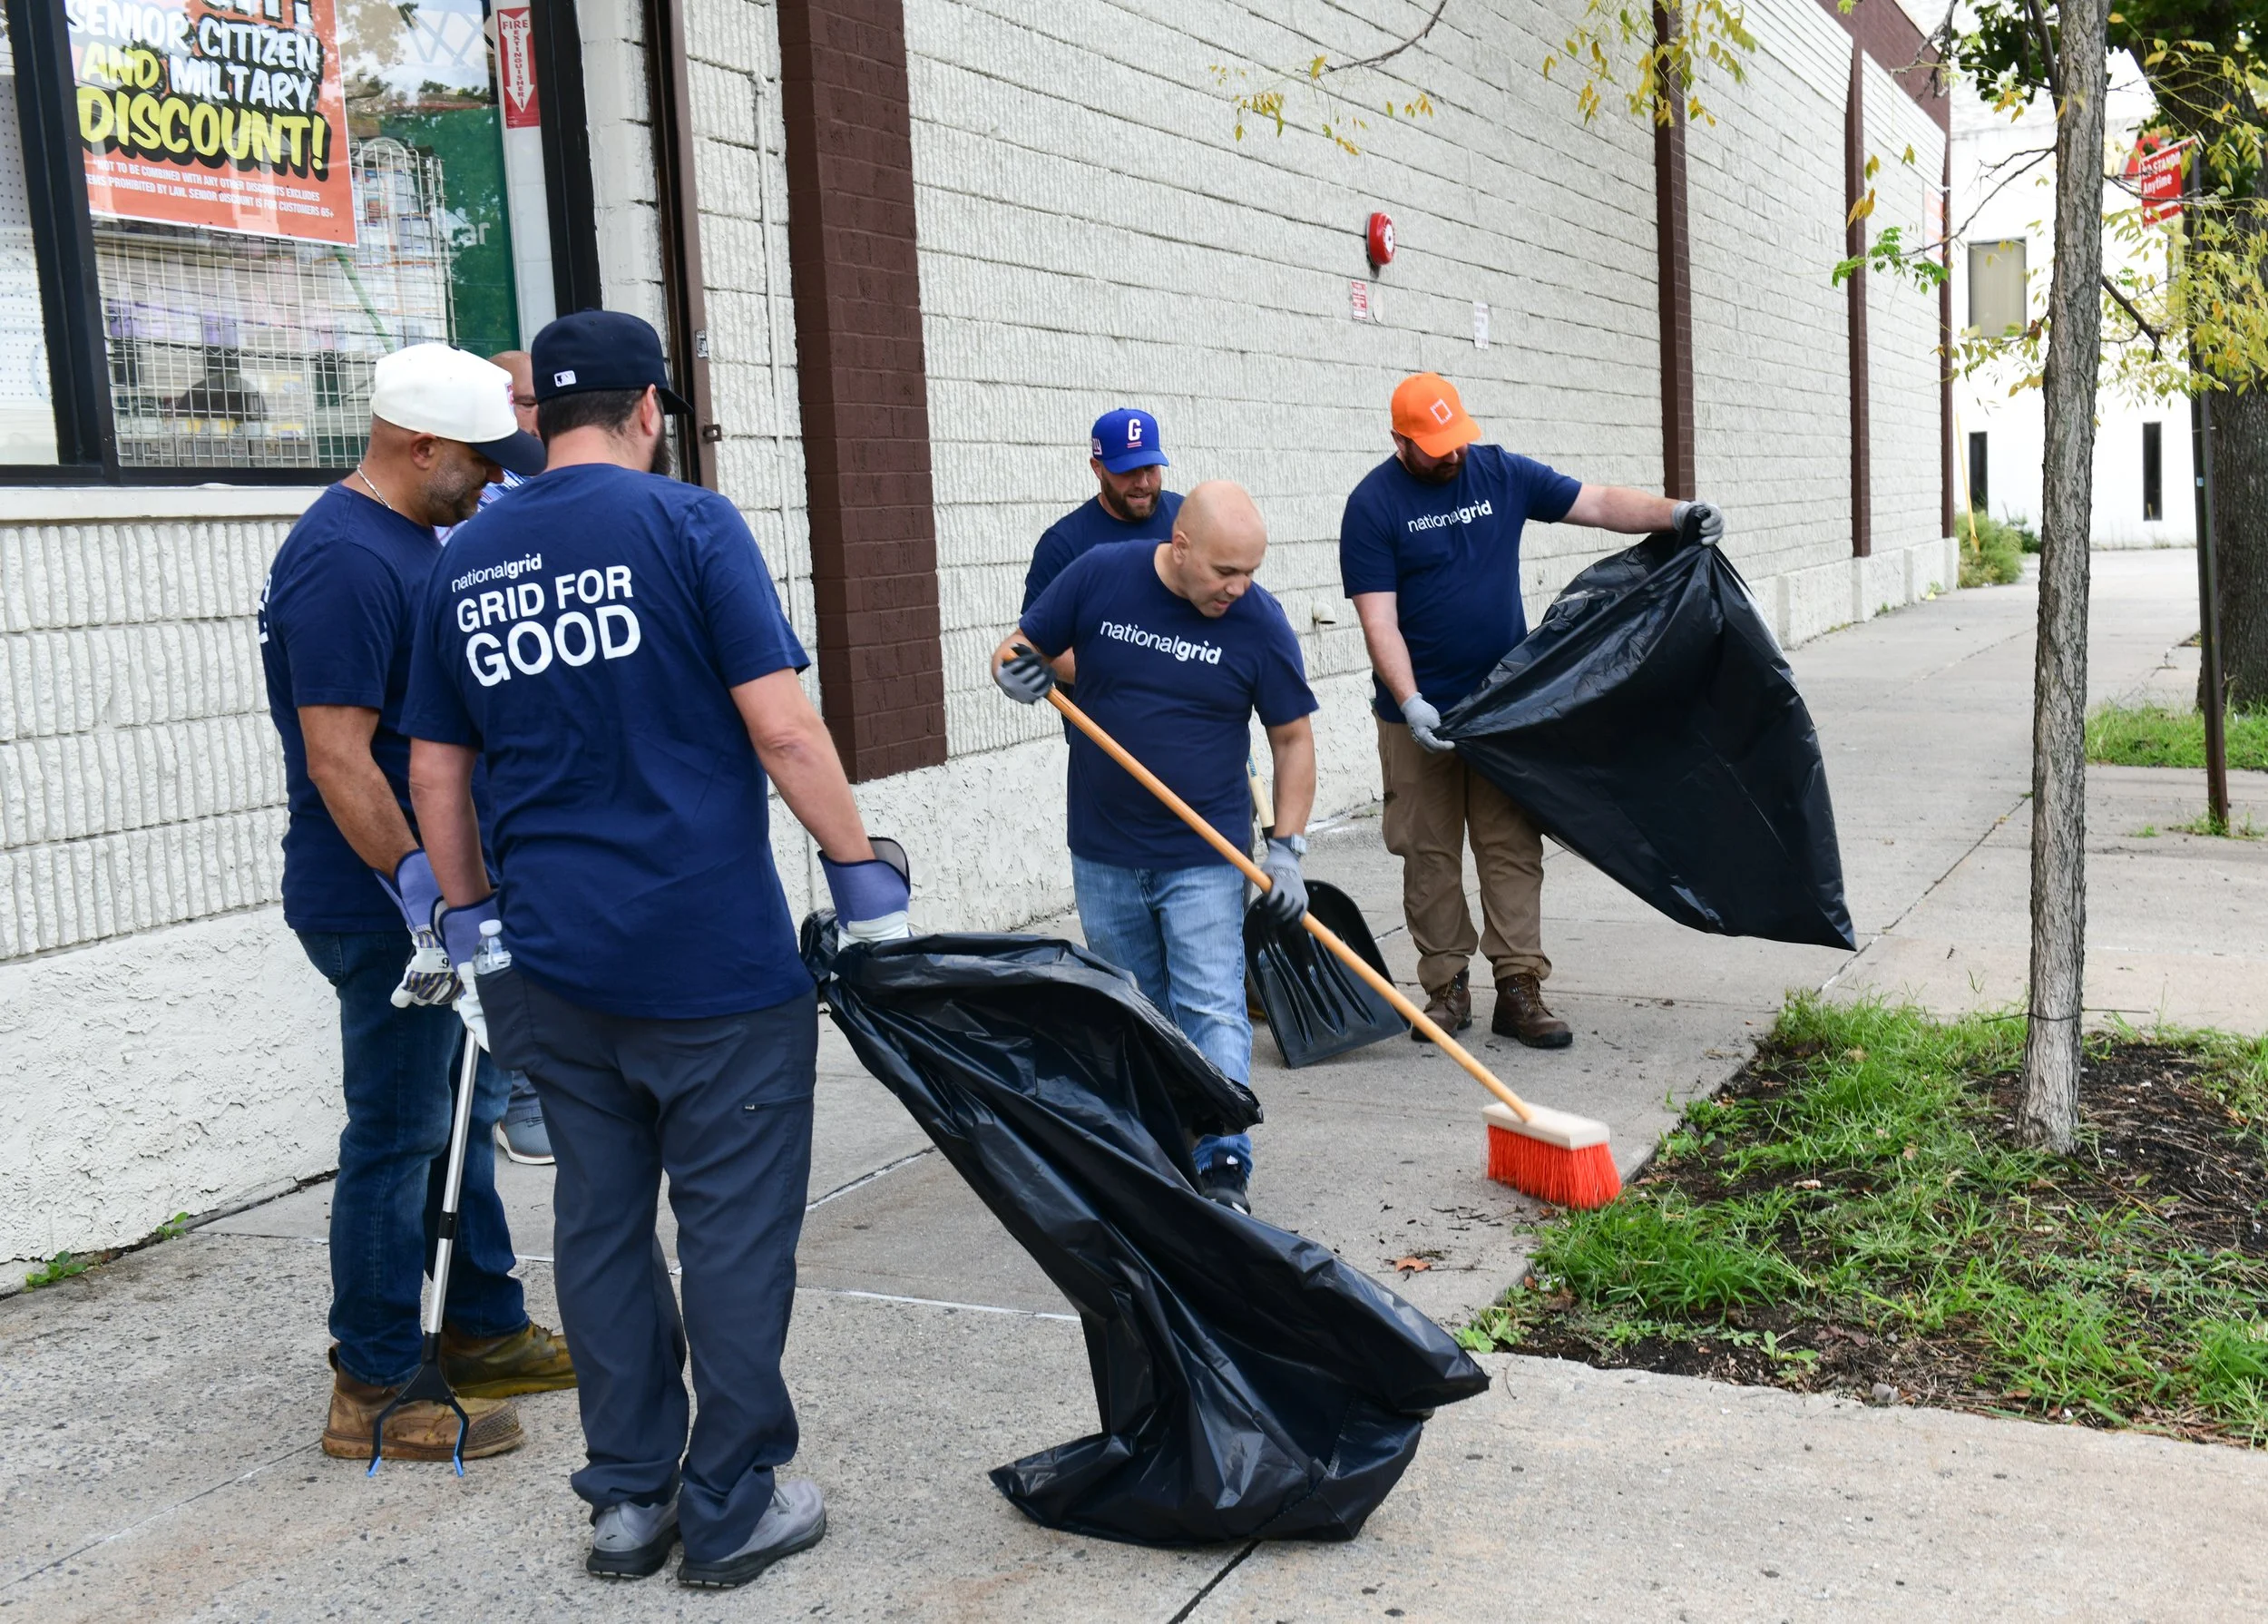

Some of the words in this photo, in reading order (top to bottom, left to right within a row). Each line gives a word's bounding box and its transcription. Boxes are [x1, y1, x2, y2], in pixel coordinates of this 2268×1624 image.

[67, 0, 191, 52] SENIOR
[198, 16, 318, 74] CITIZEN
[503, 19, 529, 30] FIRE
[82, 41, 160, 90] AND
[170, 54, 313, 113] MILTARY
[513, 30, 525, 98] EXTINGUISHER
[76, 86, 325, 170] DISCOUNT!
[108, 176, 156, 193] PROHIBITED
[156, 183, 168, 195] BY
[188, 188, 218, 201] SENIOR
[218, 191, 254, 207] DISCOUNT
[262, 199, 278, 210] FOR
[278, 201, 320, 217] CUSTOMERS
[115, 161, 128, 173] TO
[128, 164, 142, 175] BE
[141, 167, 181, 181] COMBINED
[181, 171, 202, 185] WITH
[202, 175, 219, 187] ANY
[220, 178, 245, 191] OTHER
[245, 181, 286, 197] DISCOUNTS
[285, 187, 320, 201] EXCLUDES
[2143, 173, 2172, 194] Anytime
[1128, 418, 1143, 442] G
[451, 552, 543, 592] nationalgrid
[456, 582, 544, 633] GRID
[554, 564, 634, 610] FOR
[465, 603, 641, 687] GOOD
[1100, 620, 1223, 666] nationalgrid
